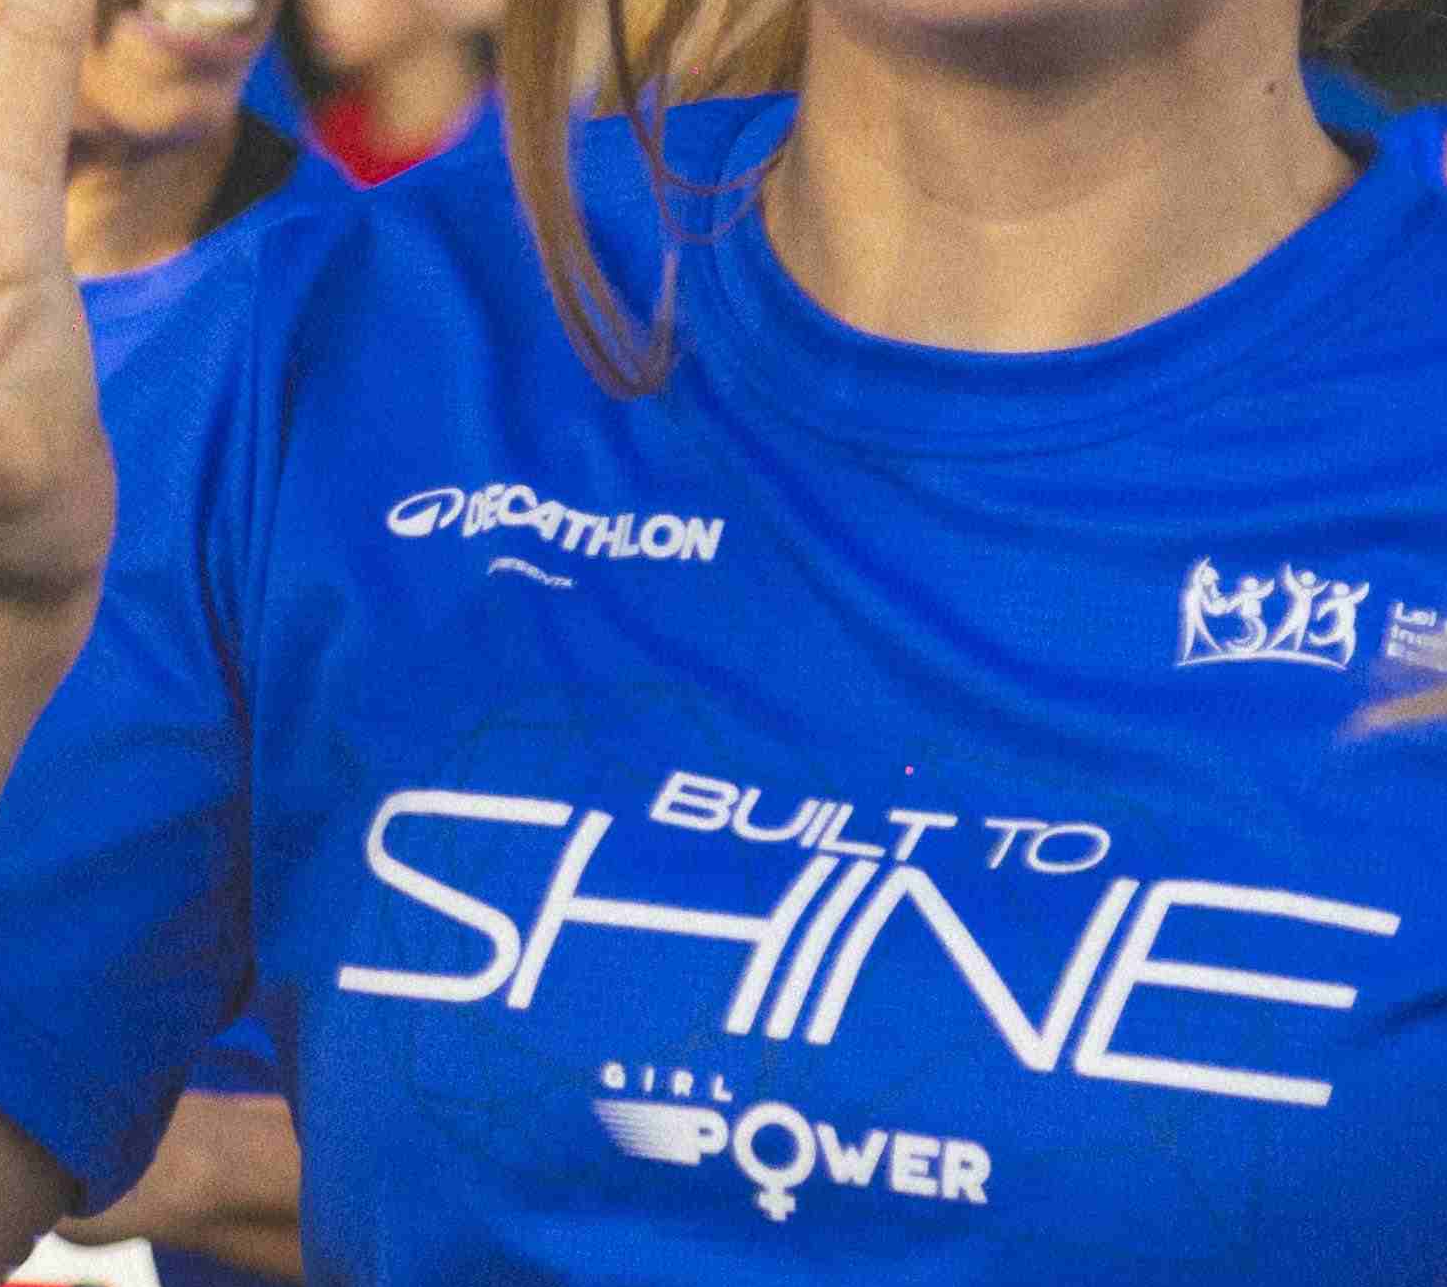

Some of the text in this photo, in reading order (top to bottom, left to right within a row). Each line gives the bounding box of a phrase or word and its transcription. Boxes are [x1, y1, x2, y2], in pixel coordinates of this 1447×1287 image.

[462, 483, 724, 561] DECATHLON
[649, 771, 1111, 874] BUILT TO
[337, 787, 1401, 1107] SHINE
[600, 1062, 733, 1102] GIRL
[595, 1100, 991, 1221] POWER
